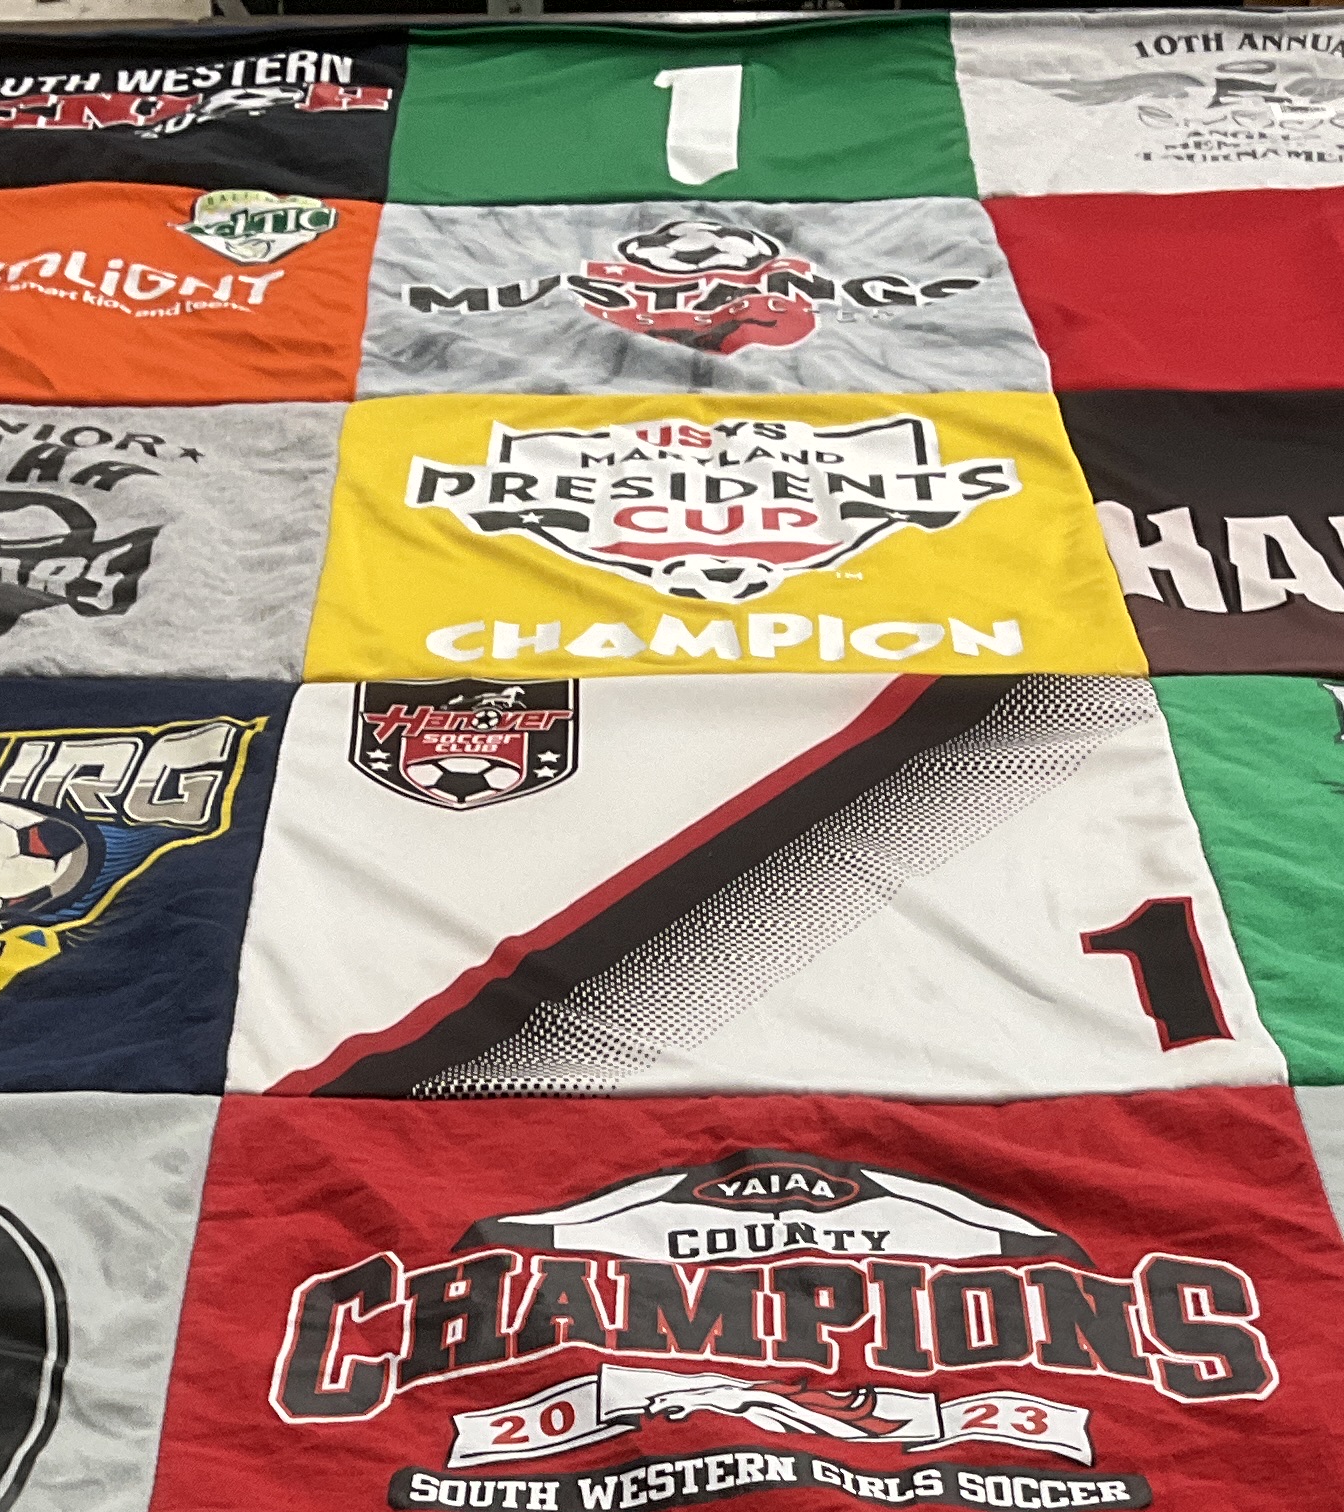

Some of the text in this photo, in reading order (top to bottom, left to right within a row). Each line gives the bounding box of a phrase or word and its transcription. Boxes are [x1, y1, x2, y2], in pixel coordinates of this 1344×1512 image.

[1132, 32, 1224, 60] 10TH
[117, 49, 353, 94] WESTERN
[654, 65, 743, 185] 1
[134, 301, 181, 318] and
[416, 463, 1014, 504] PRESIDENTS
[612, 504, 820, 535] CUP
[425, 612, 1024, 660] CHAMPION
[1080, 895, 1235, 1052] 1
[716, 1172, 836, 1200] YAIAA
[667, 1221, 891, 1260] COUNTY
[270, 1251, 1281, 1425] CHAMPIONS
[489, 1400, 1051, 1447] 20 23
[408, 1453, 1132, 1511] SOUTH WESTERN GIRLS SOCCER
